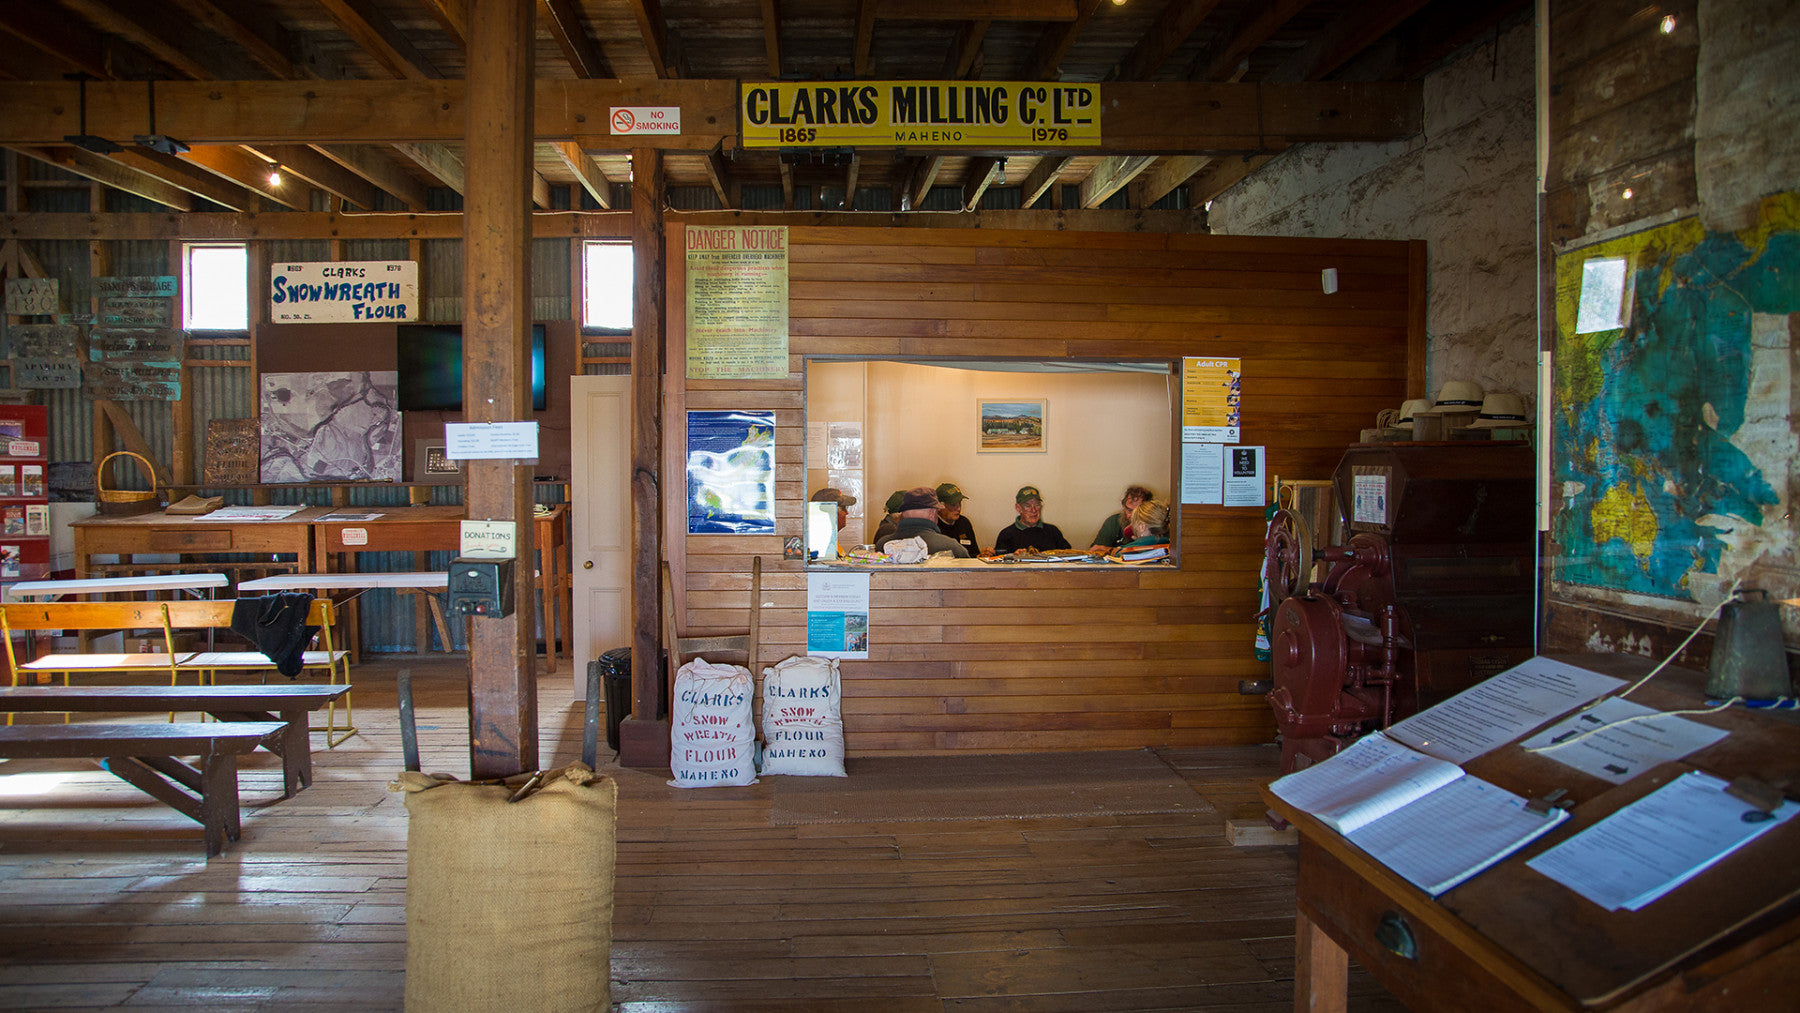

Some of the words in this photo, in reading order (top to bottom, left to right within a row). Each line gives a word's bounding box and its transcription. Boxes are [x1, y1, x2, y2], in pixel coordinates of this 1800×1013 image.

[746, 86, 879, 125] CLARKS
[892, 86, 1009, 125] MILLING
[650, 111, 665, 120] NO
[635, 121, 679, 131] SMOKING
[779, 128, 818, 143] 1865
[894, 131, 963, 142] MAHENO
[1031, 127, 1069, 142] 1976
[687, 229, 736, 250] DANGER
[741, 229, 785, 250] NOTICE
[322, 267, 366, 278] CLARKS
[352, 302, 407, 319] FLOUR
[464, 532, 511, 540] DONATIONS
[133, 610, 142, 620] 3
[681, 690, 744, 706] CLARKS
[769, 685, 830, 699] CLARKS
[780, 706, 816, 718] SNOW
[693, 715, 729, 726] SNOW
[684, 730, 736, 742] WREATH
[775, 731, 825, 741] FLOUR
[685, 747, 737, 763] FLOUR
[769, 749, 827, 759] MAHENO
[680, 768, 740, 780] MAHENO
